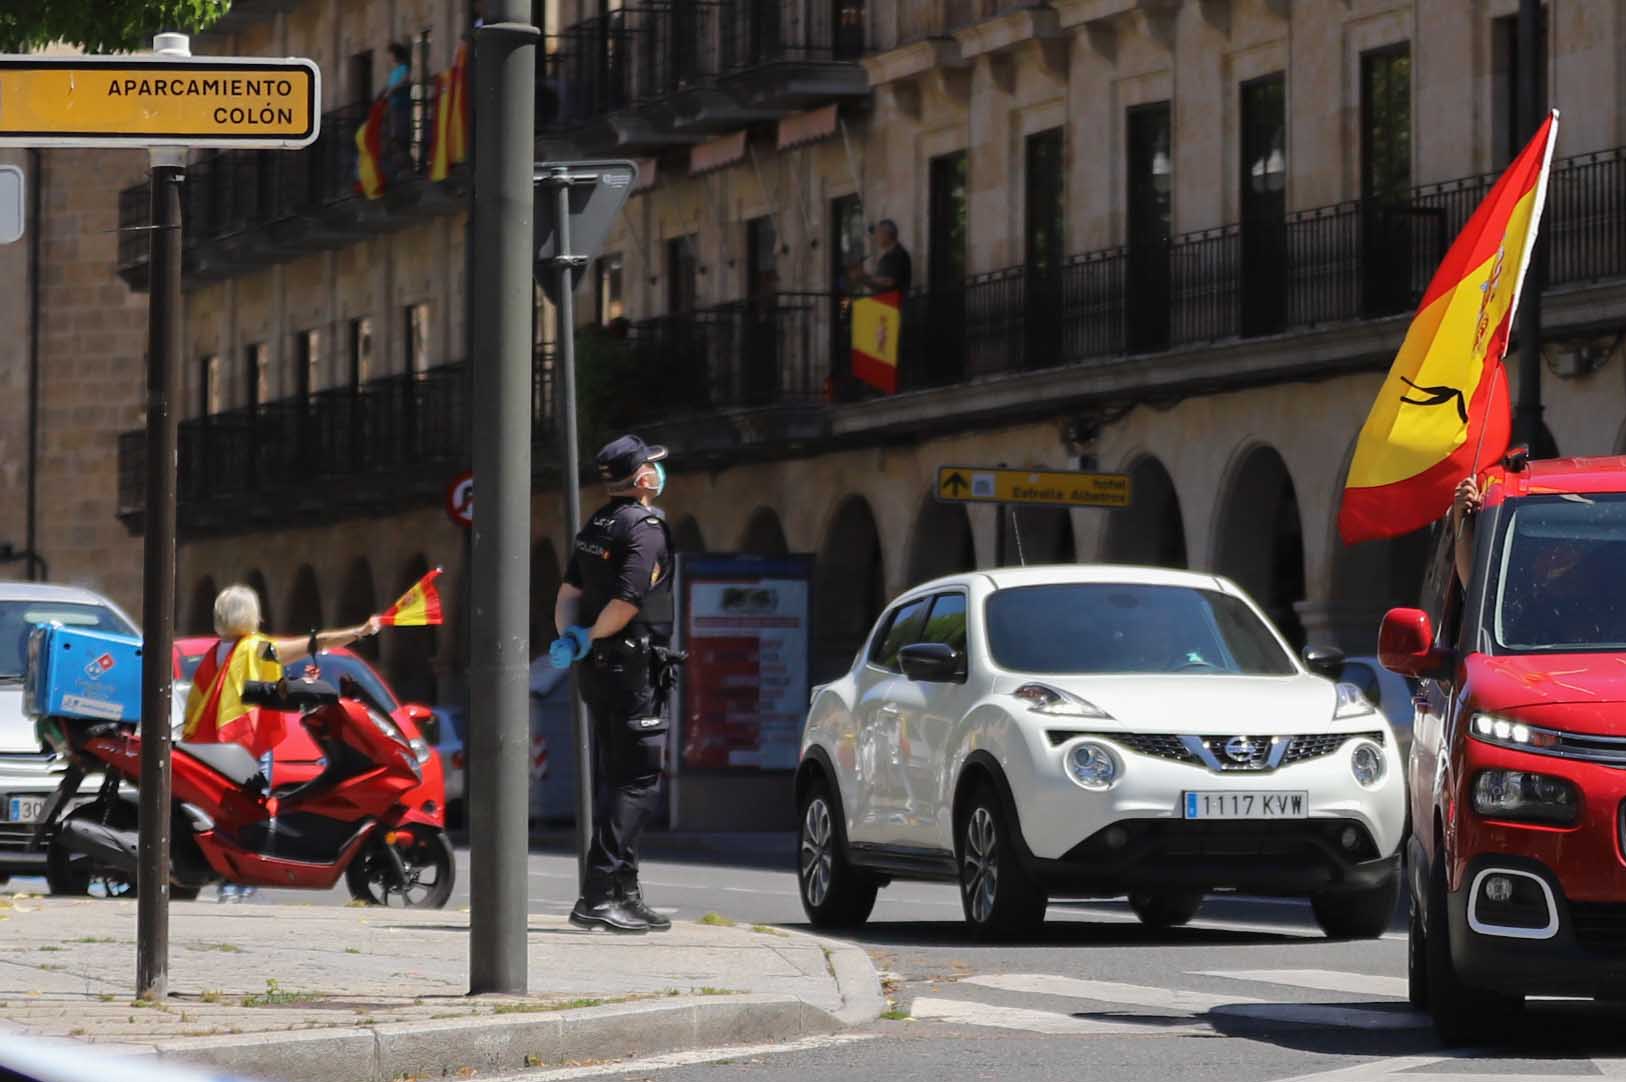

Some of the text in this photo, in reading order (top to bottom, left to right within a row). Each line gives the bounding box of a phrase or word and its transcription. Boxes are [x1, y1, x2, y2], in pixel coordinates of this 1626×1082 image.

[108, 79, 292, 96] APARCAMIENTO
[213, 102, 293, 124] COLÓN
[1203, 795, 1302, 816] 1117 KVW
